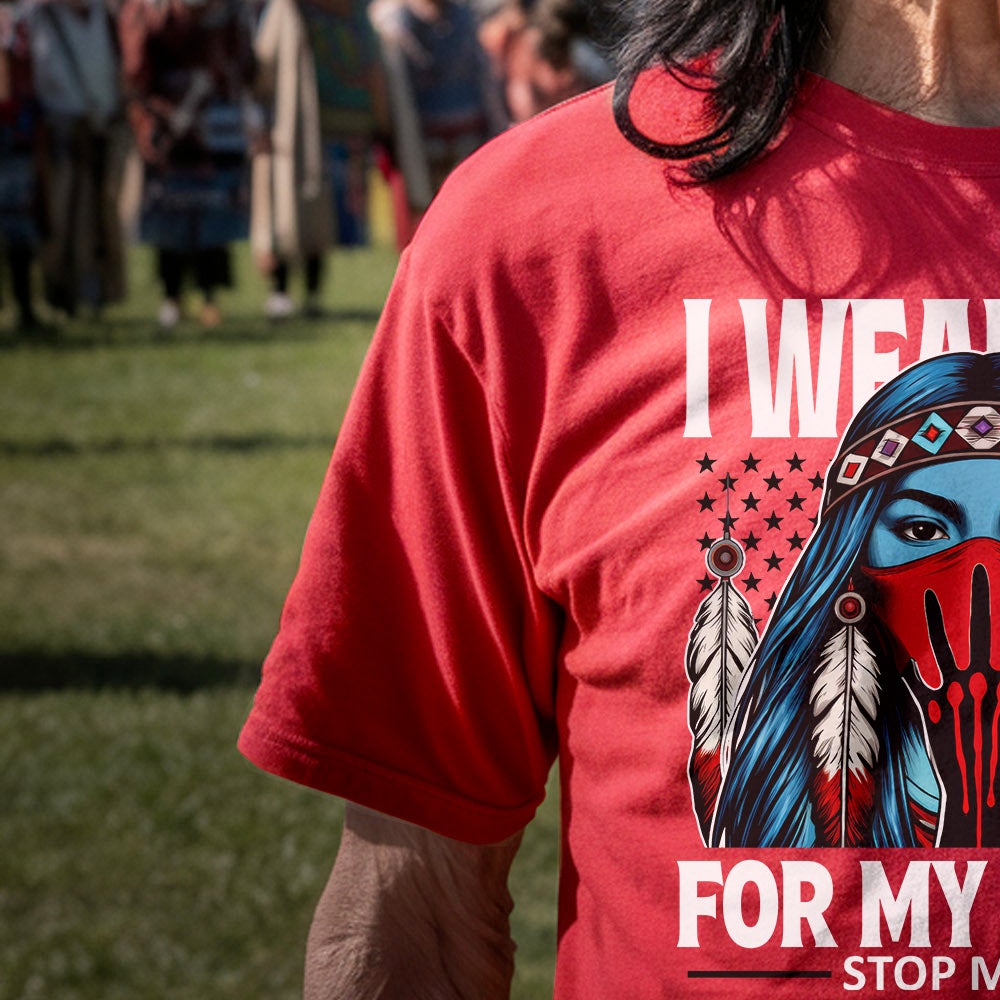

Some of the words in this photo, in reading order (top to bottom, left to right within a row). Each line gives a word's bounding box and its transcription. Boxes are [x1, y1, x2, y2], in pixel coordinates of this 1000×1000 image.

[683, 298, 712, 438] I
[676, 859, 838, 949] FOR
[858, 859, 989, 949] MY
[842, 955, 956, 992] STOP
